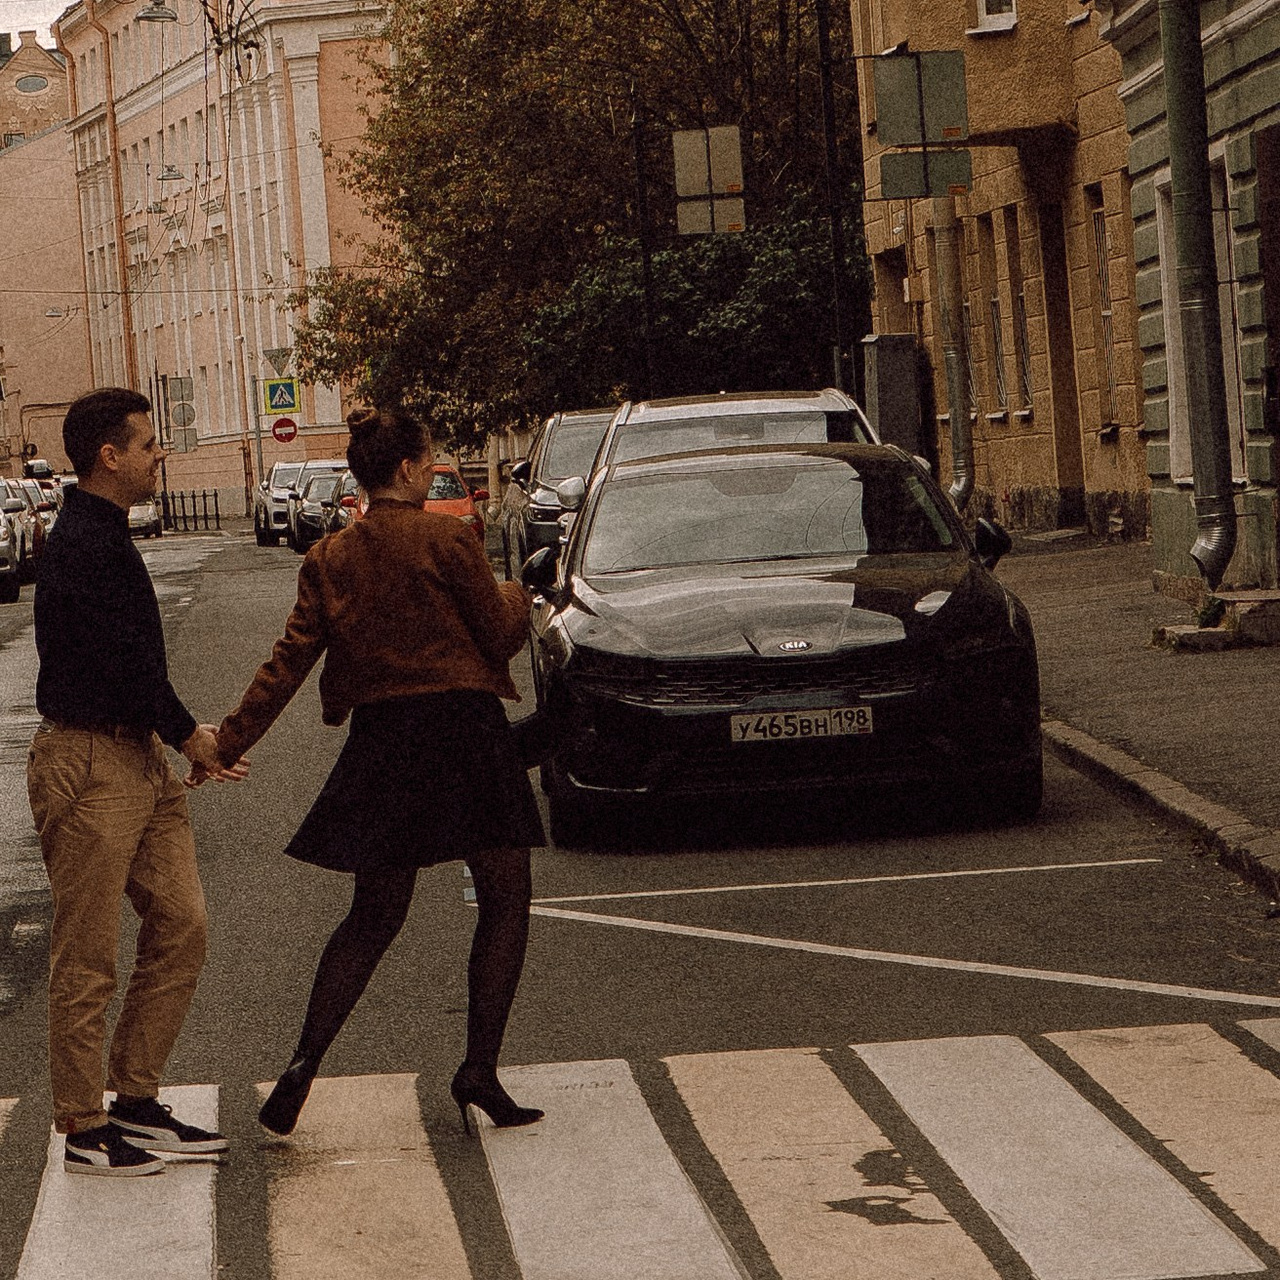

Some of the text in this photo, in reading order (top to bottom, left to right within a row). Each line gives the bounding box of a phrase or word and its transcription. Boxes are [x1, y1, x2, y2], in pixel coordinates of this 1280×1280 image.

[780, 641, 808, 650] KIA
[739, 709, 868, 739] У465ВН 198
